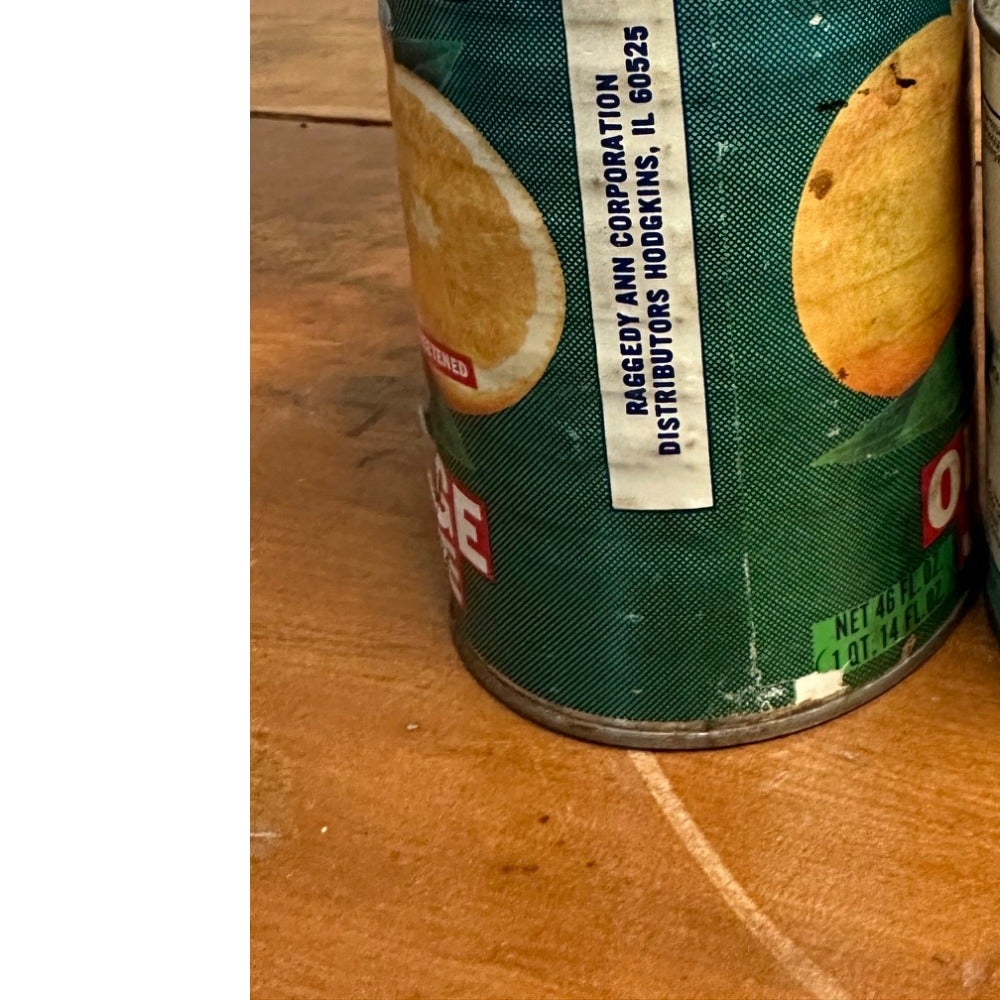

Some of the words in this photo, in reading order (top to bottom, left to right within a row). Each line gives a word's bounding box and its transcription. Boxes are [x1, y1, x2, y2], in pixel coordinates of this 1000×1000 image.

[623, 26, 653, 104] 60525
[595, 74, 634, 247] CORPORATION
[631, 112, 655, 135] IL
[635, 146, 667, 279] HODGKINS,
[612, 258, 638, 306] ANN
[616, 312, 648, 415] RAGGEDY
[646, 289, 681, 455] DISTRIBUTORS
[835, 603, 869, 640] NET
[876, 587, 895, 618] 46
[880, 617, 899, 647] 14
